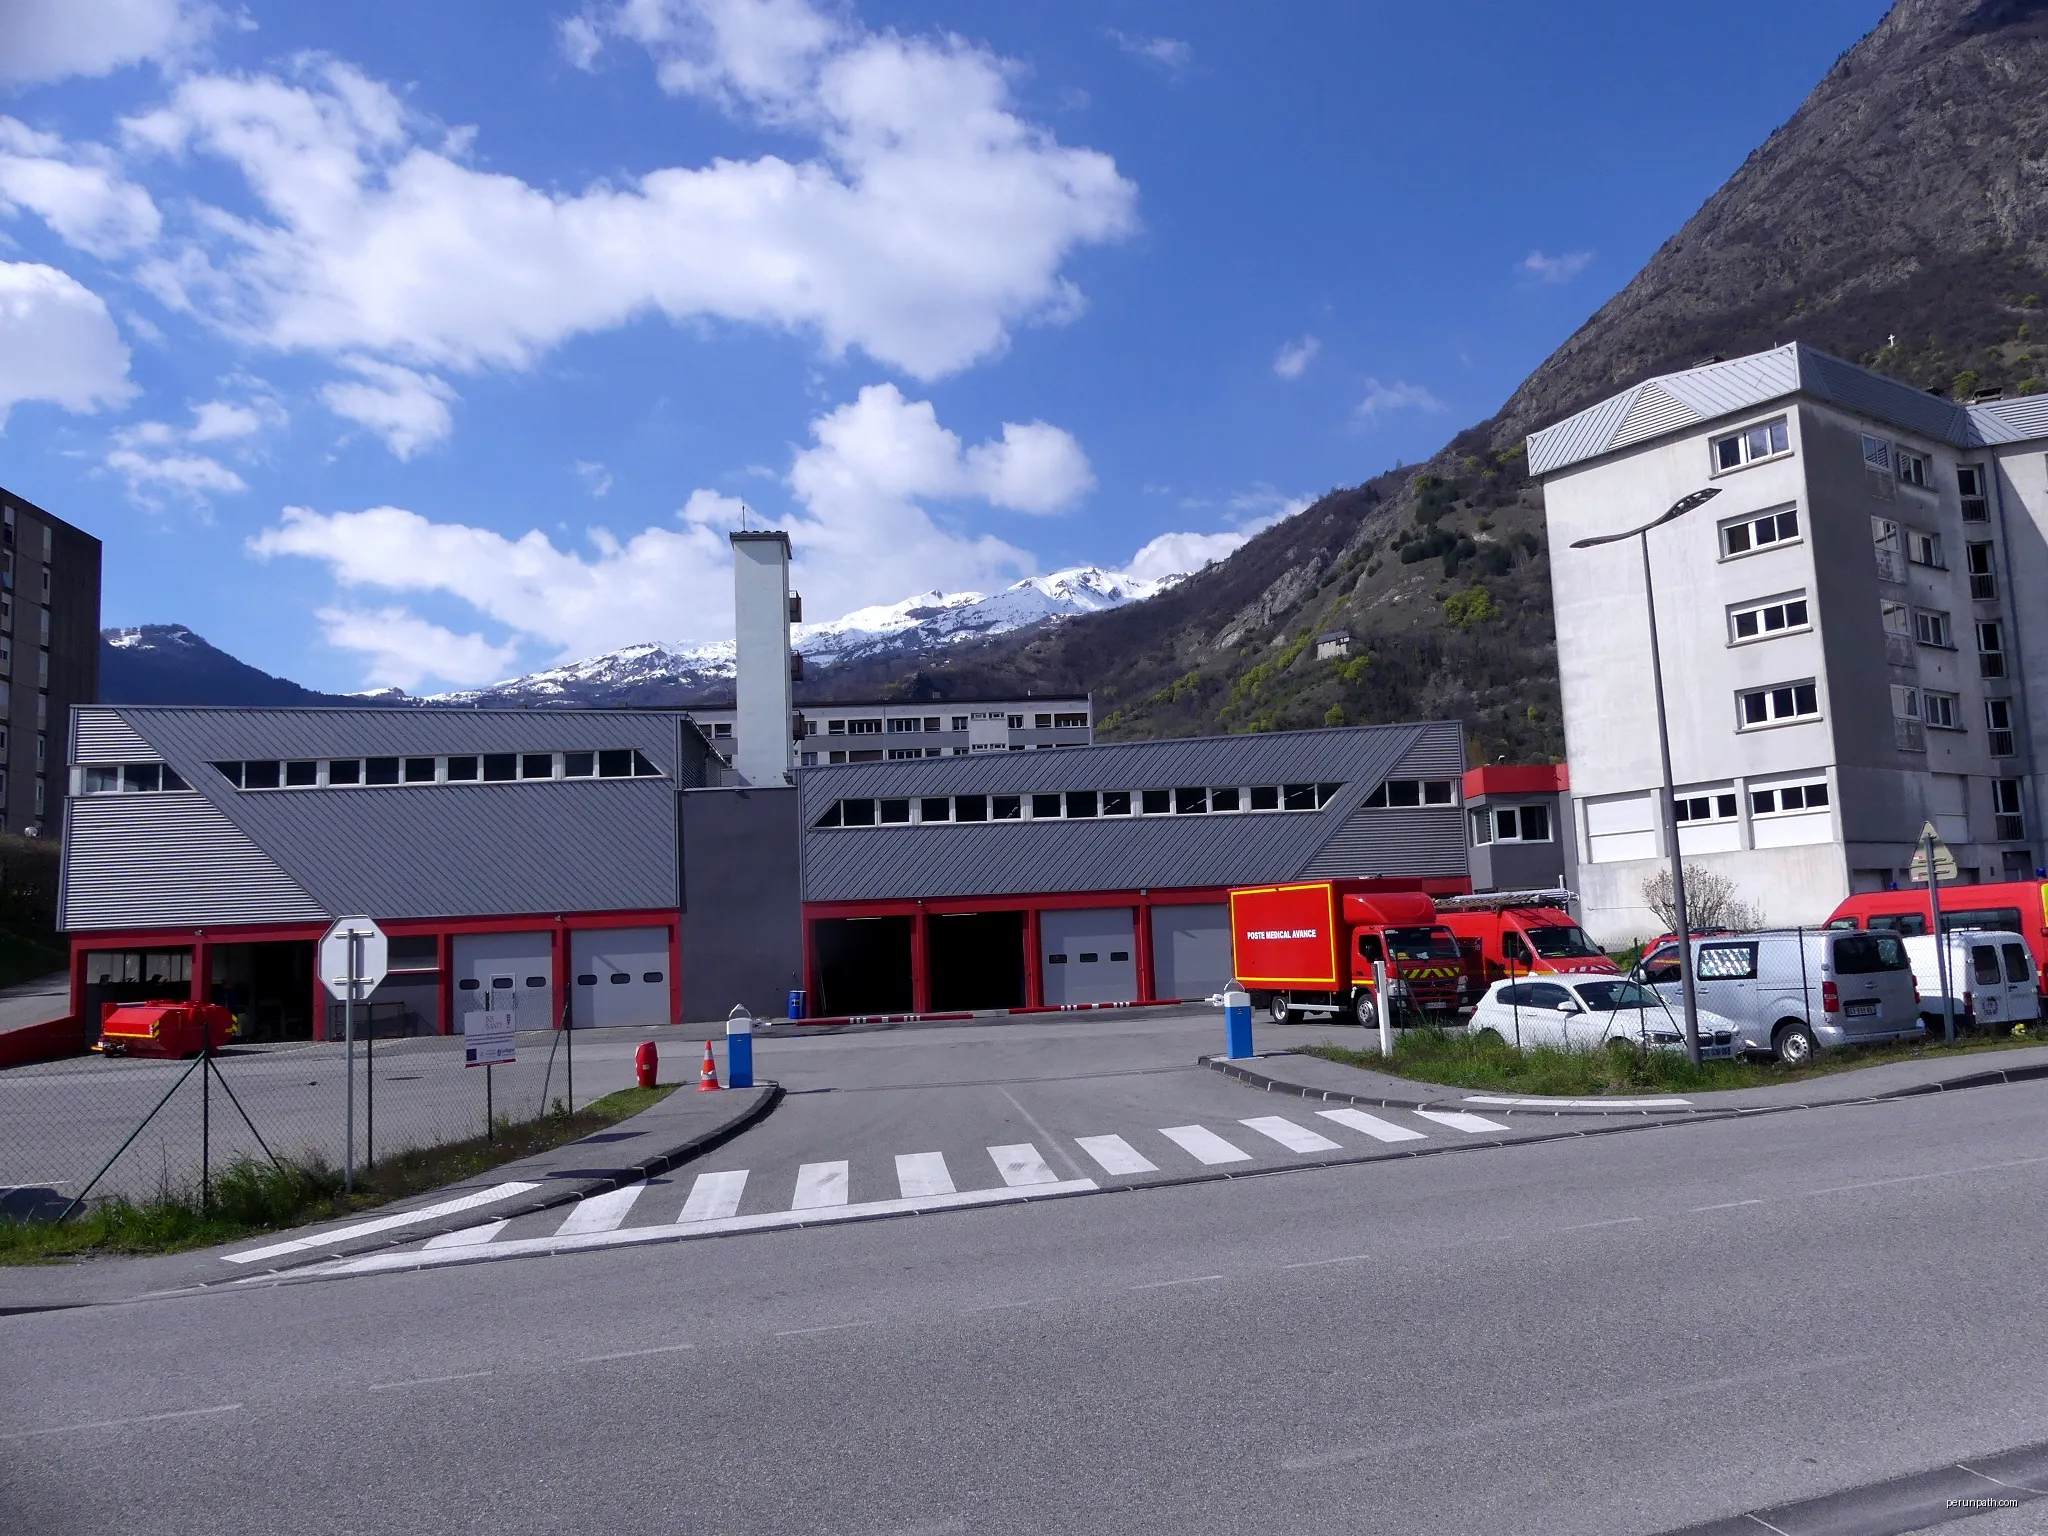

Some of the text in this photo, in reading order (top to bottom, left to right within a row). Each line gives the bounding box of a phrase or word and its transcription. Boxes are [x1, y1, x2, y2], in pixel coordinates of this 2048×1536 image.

[1247, 929, 1317, 940] POSTE MEDICAL AVANCE
